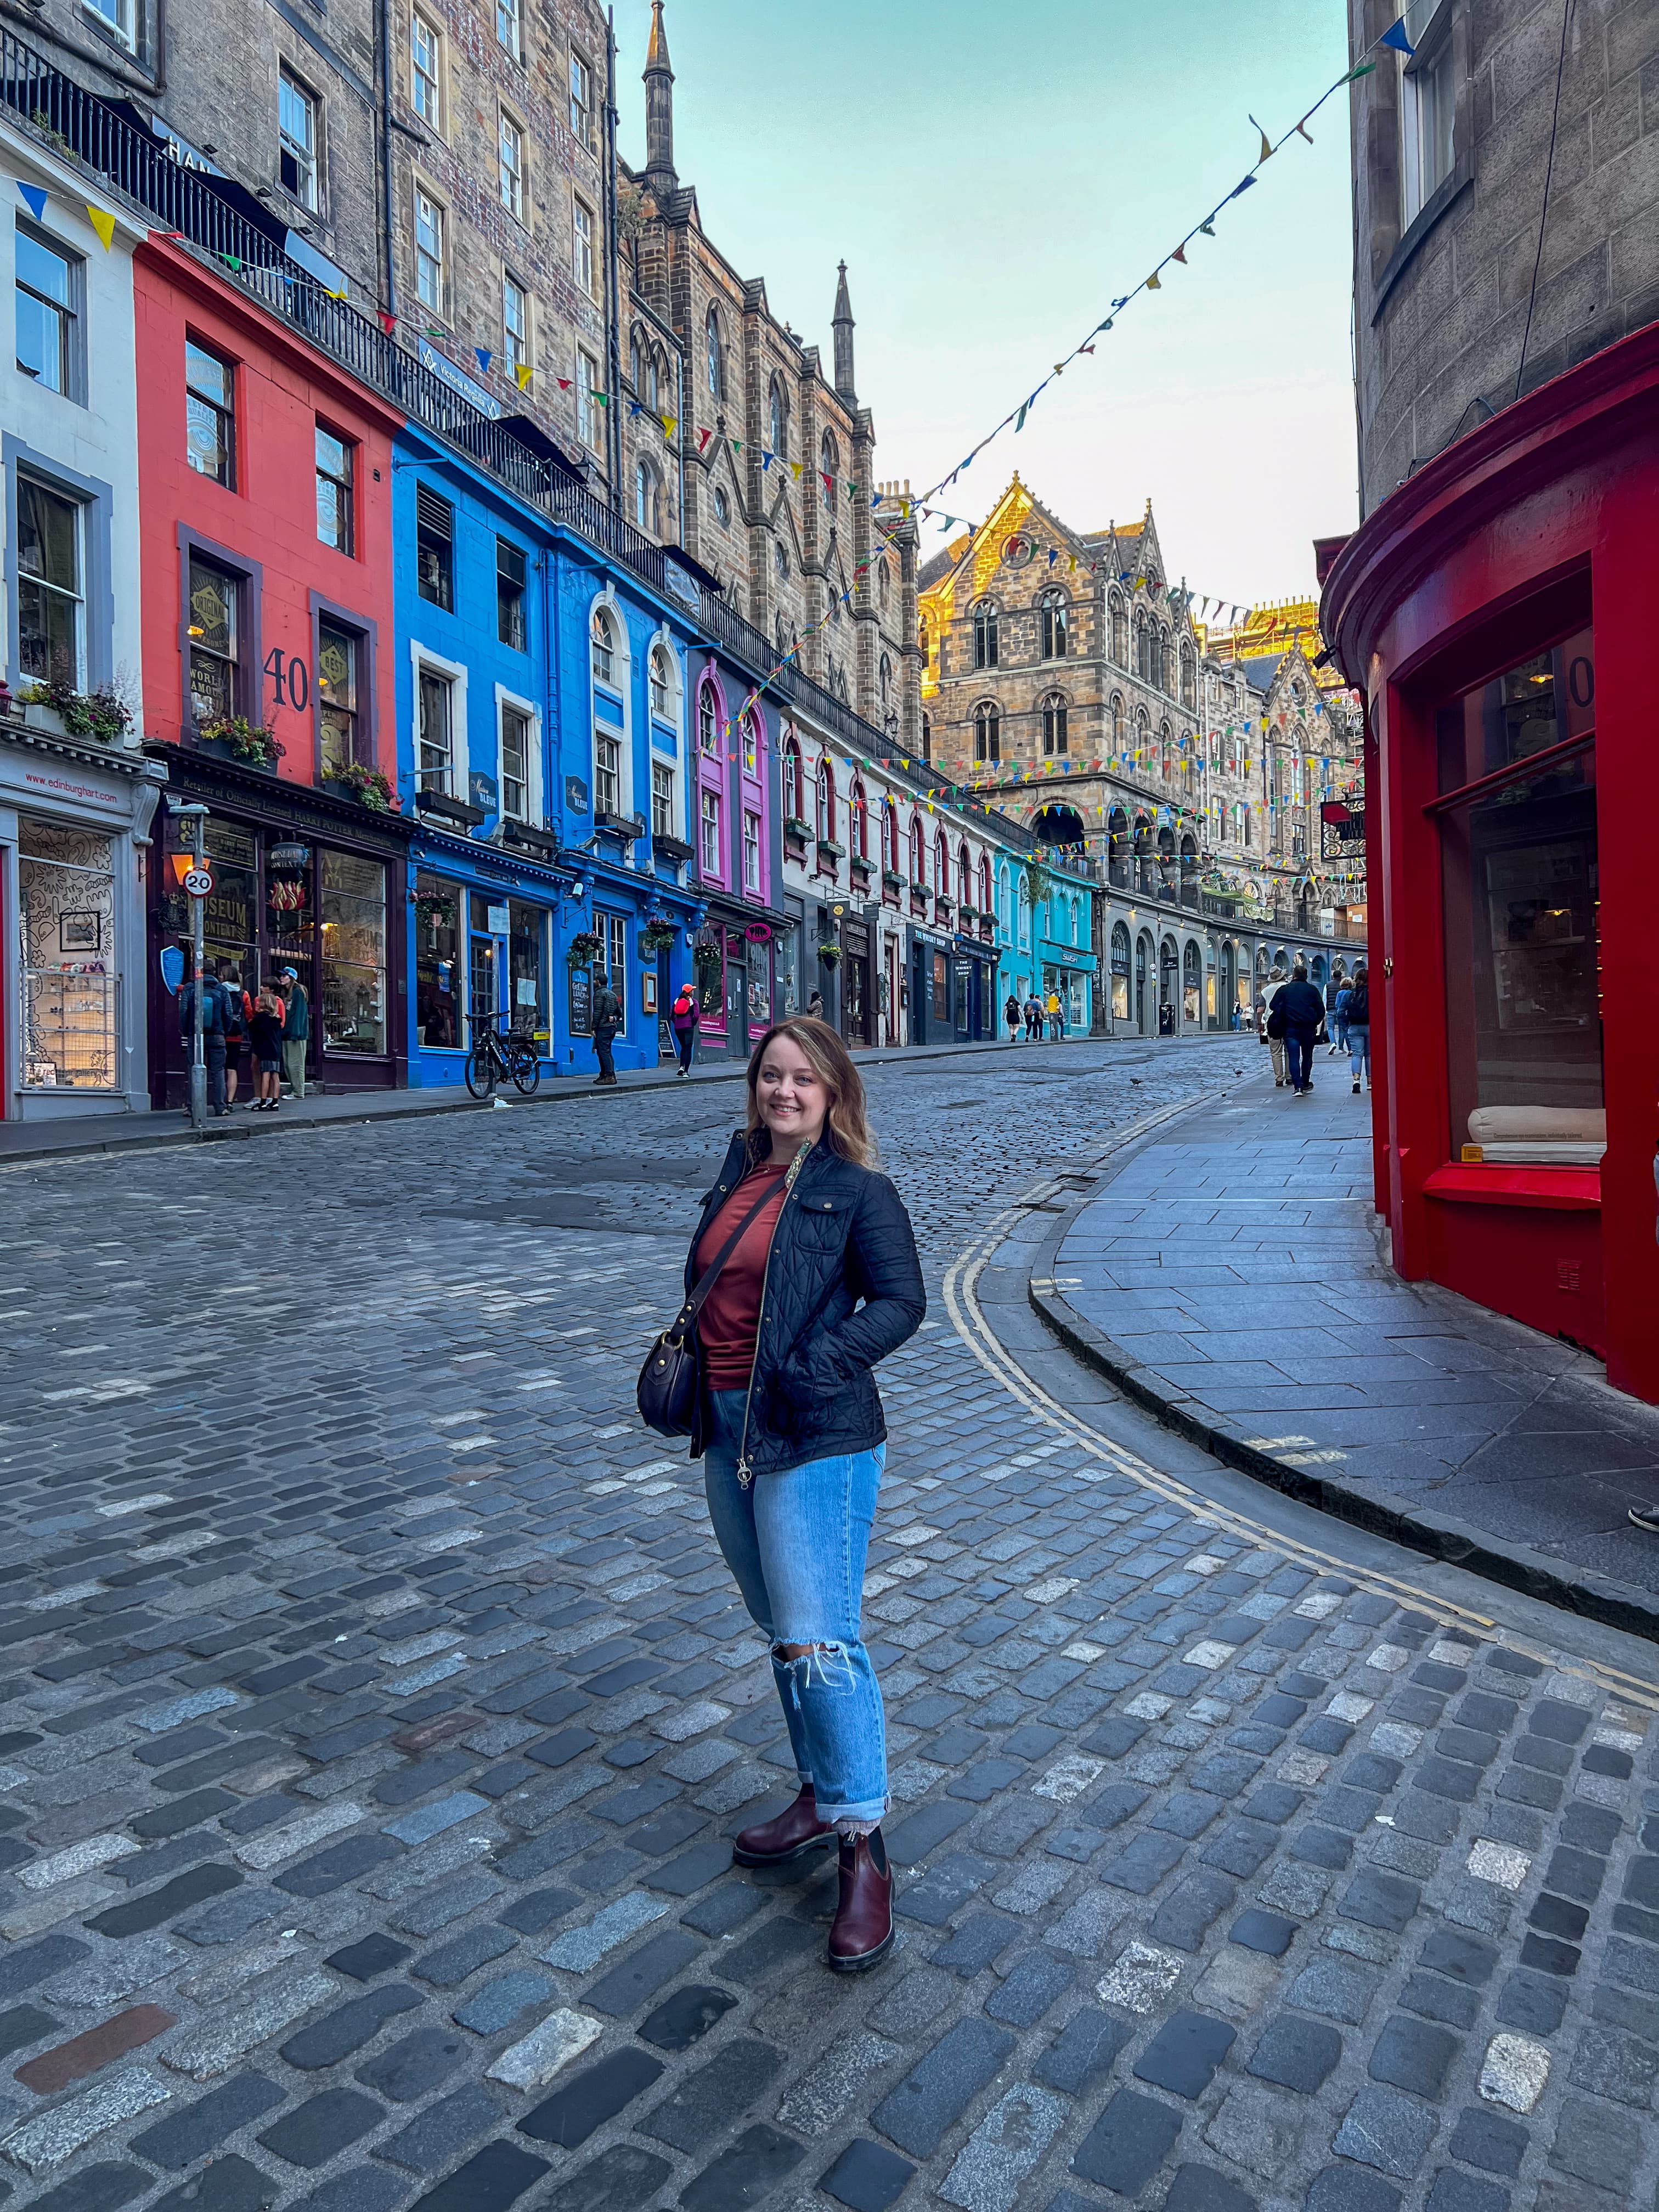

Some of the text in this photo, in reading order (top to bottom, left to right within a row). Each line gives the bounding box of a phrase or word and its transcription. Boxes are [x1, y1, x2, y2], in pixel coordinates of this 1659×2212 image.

[439, 363, 485, 407] Victoria Regalia
[325, 657, 343, 674] BEST
[190, 668, 224, 687] WORLD
[263, 647, 308, 712] 40
[191, 680, 224, 699] AMOUS
[25, 774, 117, 803] www.edinburghart.com
[183, 777, 213, 795] Retailer
[216, 787, 223, 798] of
[227, 790, 261, 810] Officially
[295, 811, 320, 827] HARRY
[322, 820, 352, 837] POTTER
[188, 876, 210, 889] 20
[1062, 953, 1077, 963] SWISH
[75, 1070, 98, 1078] gallery
